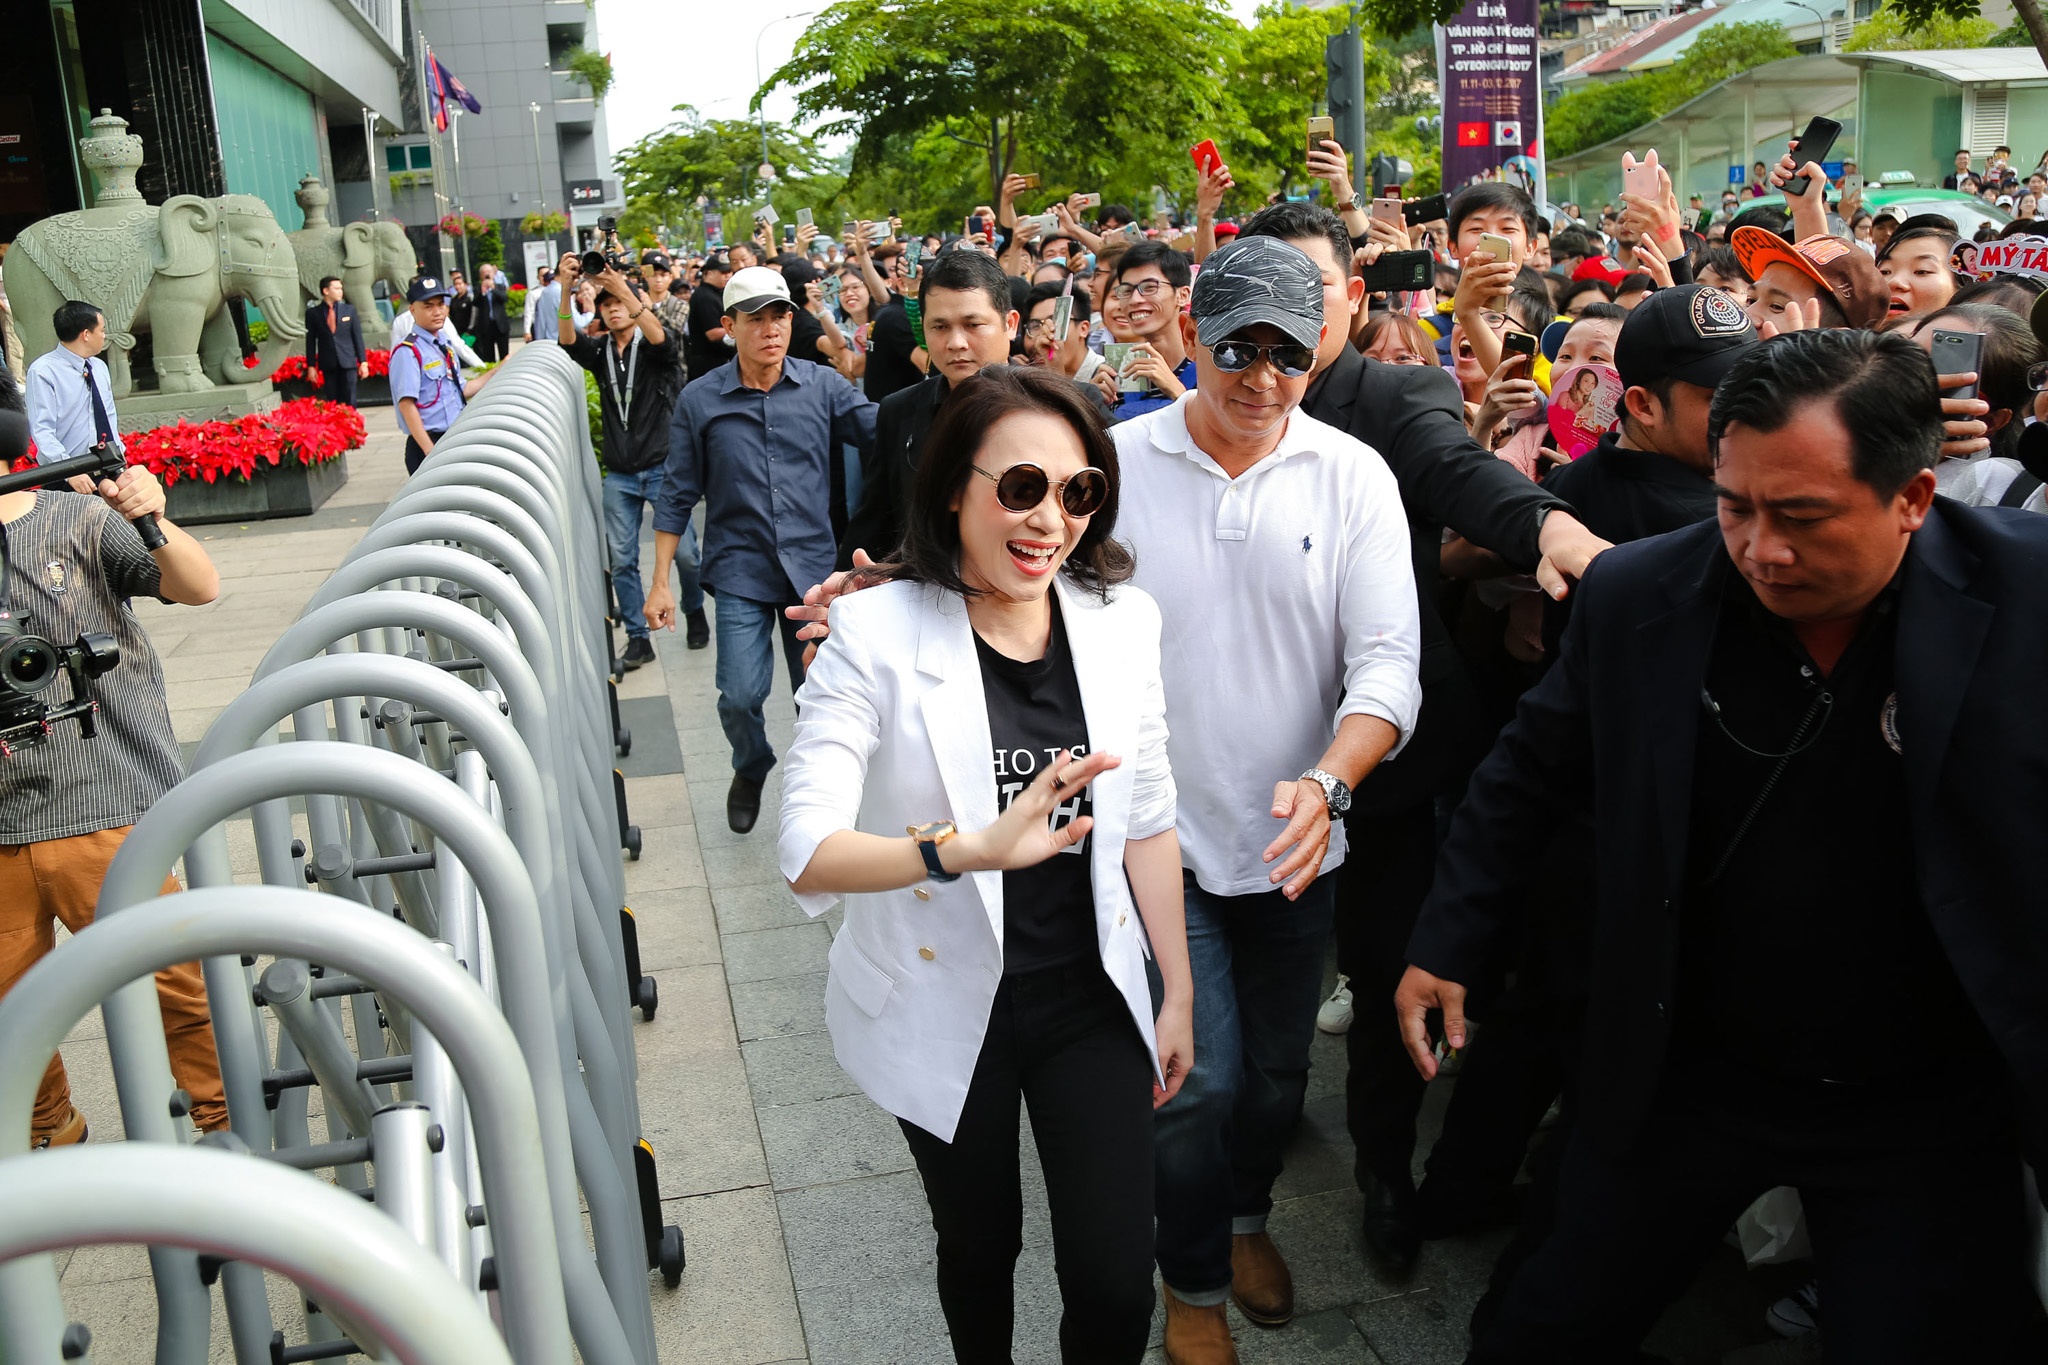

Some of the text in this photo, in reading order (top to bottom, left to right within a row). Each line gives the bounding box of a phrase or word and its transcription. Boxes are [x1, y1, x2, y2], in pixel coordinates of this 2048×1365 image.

[1510, 61, 1532, 71] 2017
[1980, 243, 2019, 267] MỸ
[1694, 297, 1706, 325] GOLDEN
